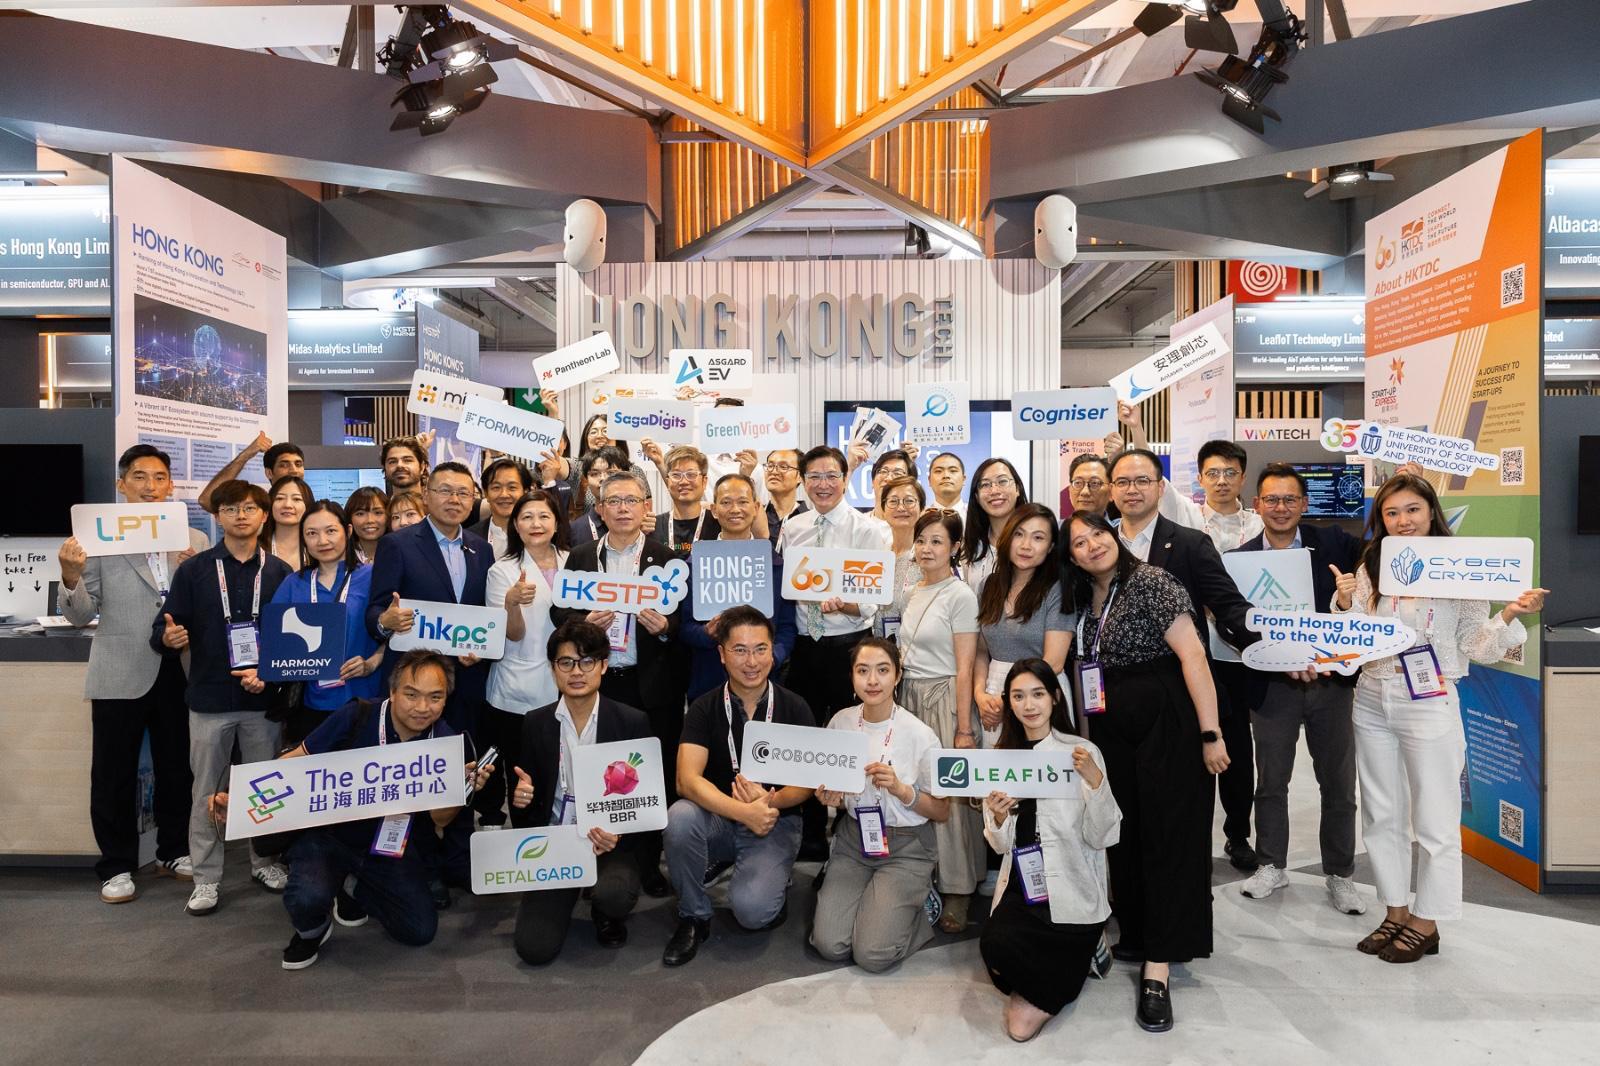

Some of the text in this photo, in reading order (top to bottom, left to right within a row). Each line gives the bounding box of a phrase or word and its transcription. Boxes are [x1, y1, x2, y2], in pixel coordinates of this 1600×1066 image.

[1438, 208, 1456, 220] WORLD
[1548, 215, 1600, 233] Albaca
[11, 238, 44, 259] Hong
[48, 238, 81, 259] Kong
[132, 223, 224, 276] HONG KONG
[1402, 232, 1423, 253] HKTDC
[10, 280, 66, 290] semiconductor,
[68, 279, 83, 288] GPU
[84, 279, 99, 288] and
[1374, 258, 1440, 296] About HKTDC
[584, 292, 924, 360] HONG KONG
[934, 294, 954, 359] TECH
[288, 343, 383, 356] Midas Analytics Limited
[1292, 334, 1342, 348] Technology
[424, 347, 442, 366] HONG
[555, 348, 611, 376] Pantheon Lab
[1153, 336, 1208, 372] 安理創芯
[709, 368, 730, 380] EV
[1483, 362, 1511, 376] JOURNEY
[1512, 360, 1520, 369] TO
[1476, 373, 1516, 387] SUCCESS FOR
[1372, 387, 1396, 399] START-UP
[1375, 396, 1397, 406] EXPRESS
[1472, 386, 1502, 398] START-UPS
[614, 410, 686, 430] SagaDigits
[1019, 404, 1109, 425] Cogniser
[477, 415, 556, 448] FORMWORK
[706, 420, 770, 441] GreenVigor
[913, 425, 964, 434] EIELING
[1388, 430, 1470, 451] THE HONG KONG
[1384, 451, 1471, 472] AND TECHNOLOGY
[1386, 440, 1495, 466] UNIVERSITY OF SCIENCE
[5, 553, 47, 562] Feel Free
[1429, 558, 1520, 568] CYBER
[701, 556, 765, 588] HONG TECH
[842, 575, 882, 588] HKTDC
[1428, 572, 1520, 583] CRYSTAL
[562, 578, 658, 604] HKSTP
[701, 581, 753, 604] KONG
[418, 615, 488, 648] hkpc
[1254, 614, 1394, 636] From Hong Kong
[1270, 630, 1374, 647] to the World
[272, 658, 332, 668] HARMONY
[771, 747, 857, 770] ROBOCORE
[306, 754, 447, 792] The Cradle
[309, 776, 447, 812] 出海服務中心
[610, 811, 637, 823] BBR
[484, 866, 584, 886] PETALGARD
